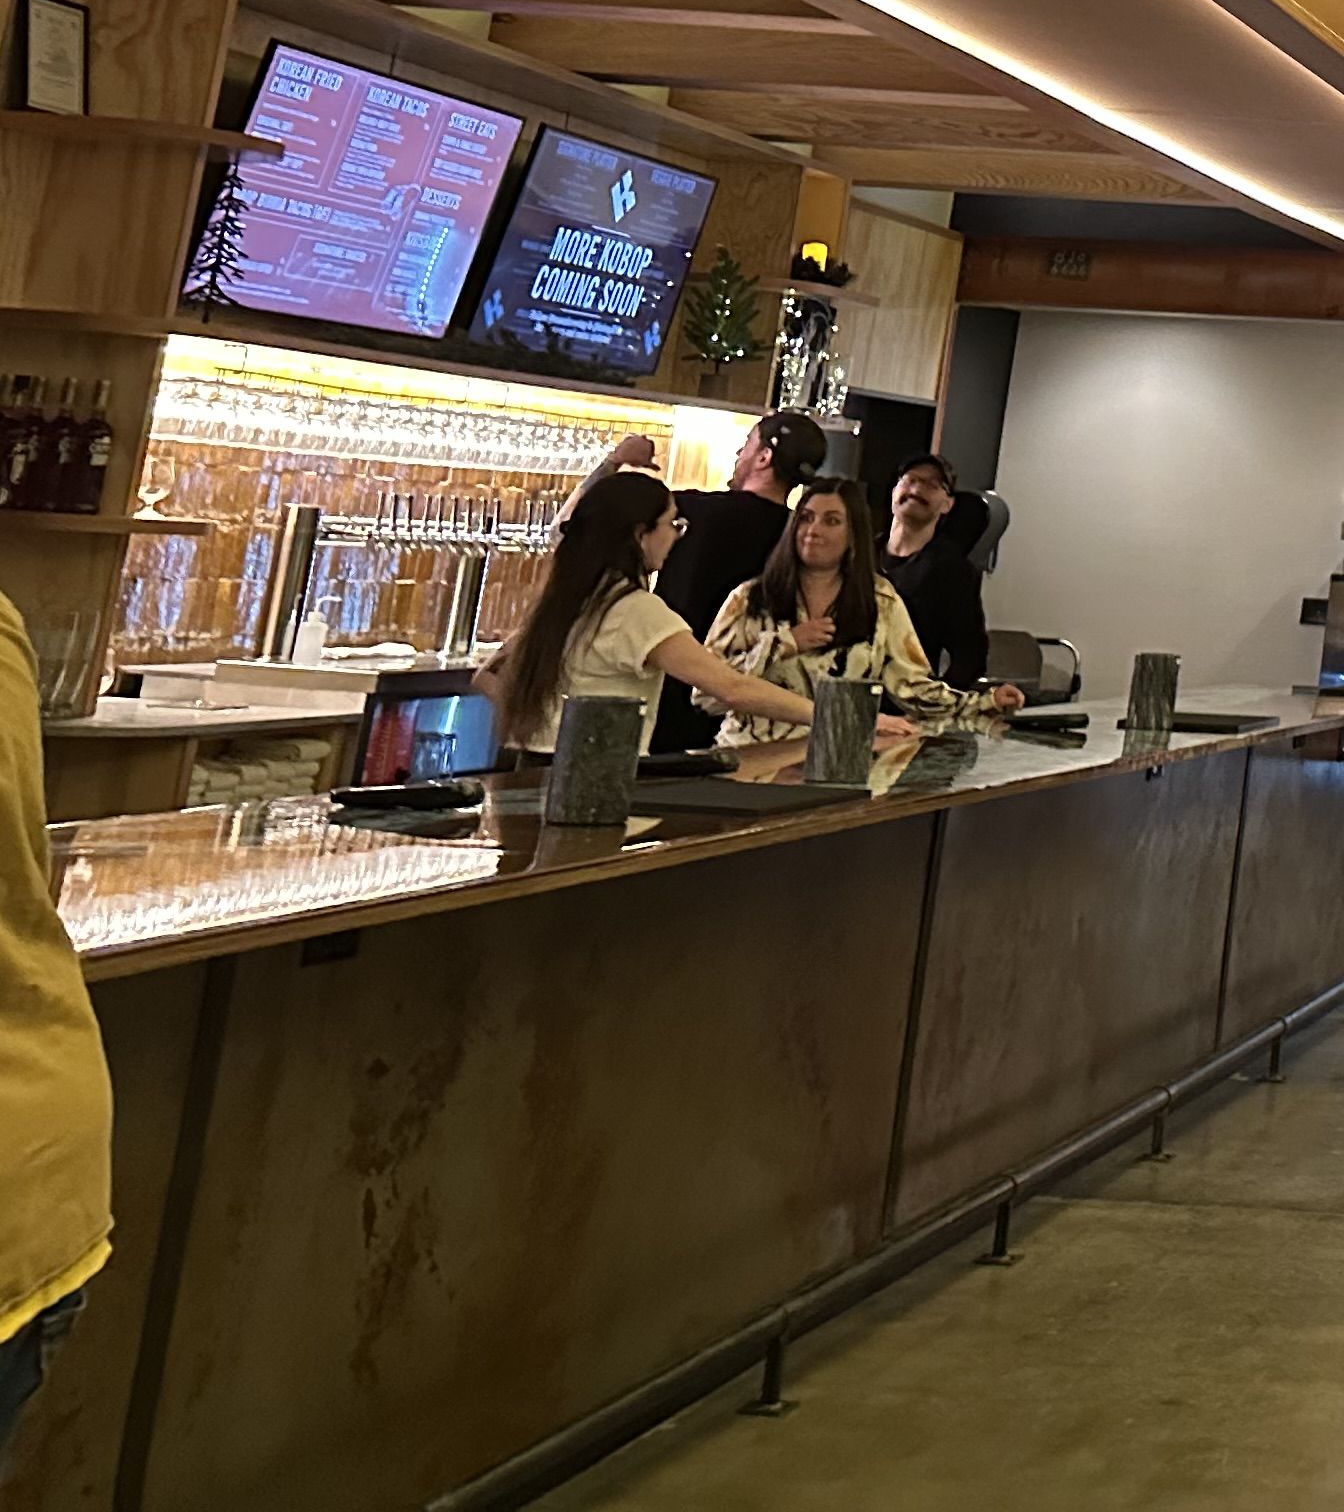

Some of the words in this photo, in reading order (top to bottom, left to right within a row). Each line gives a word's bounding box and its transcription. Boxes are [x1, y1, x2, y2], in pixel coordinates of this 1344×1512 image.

[269, 75, 313, 102] CHICKEN
[276, 58, 314, 83] KOREAN
[314, 68, 344, 91] FRIED
[367, 86, 403, 110] KOREAN
[401, 97, 430, 118] TACOS
[448, 112, 480, 133] STREET
[549, 226, 602, 268] MORE
[597, 238, 653, 279] KOBOP
[531, 264, 601, 309] COMING
[597, 279, 645, 318] SOON
